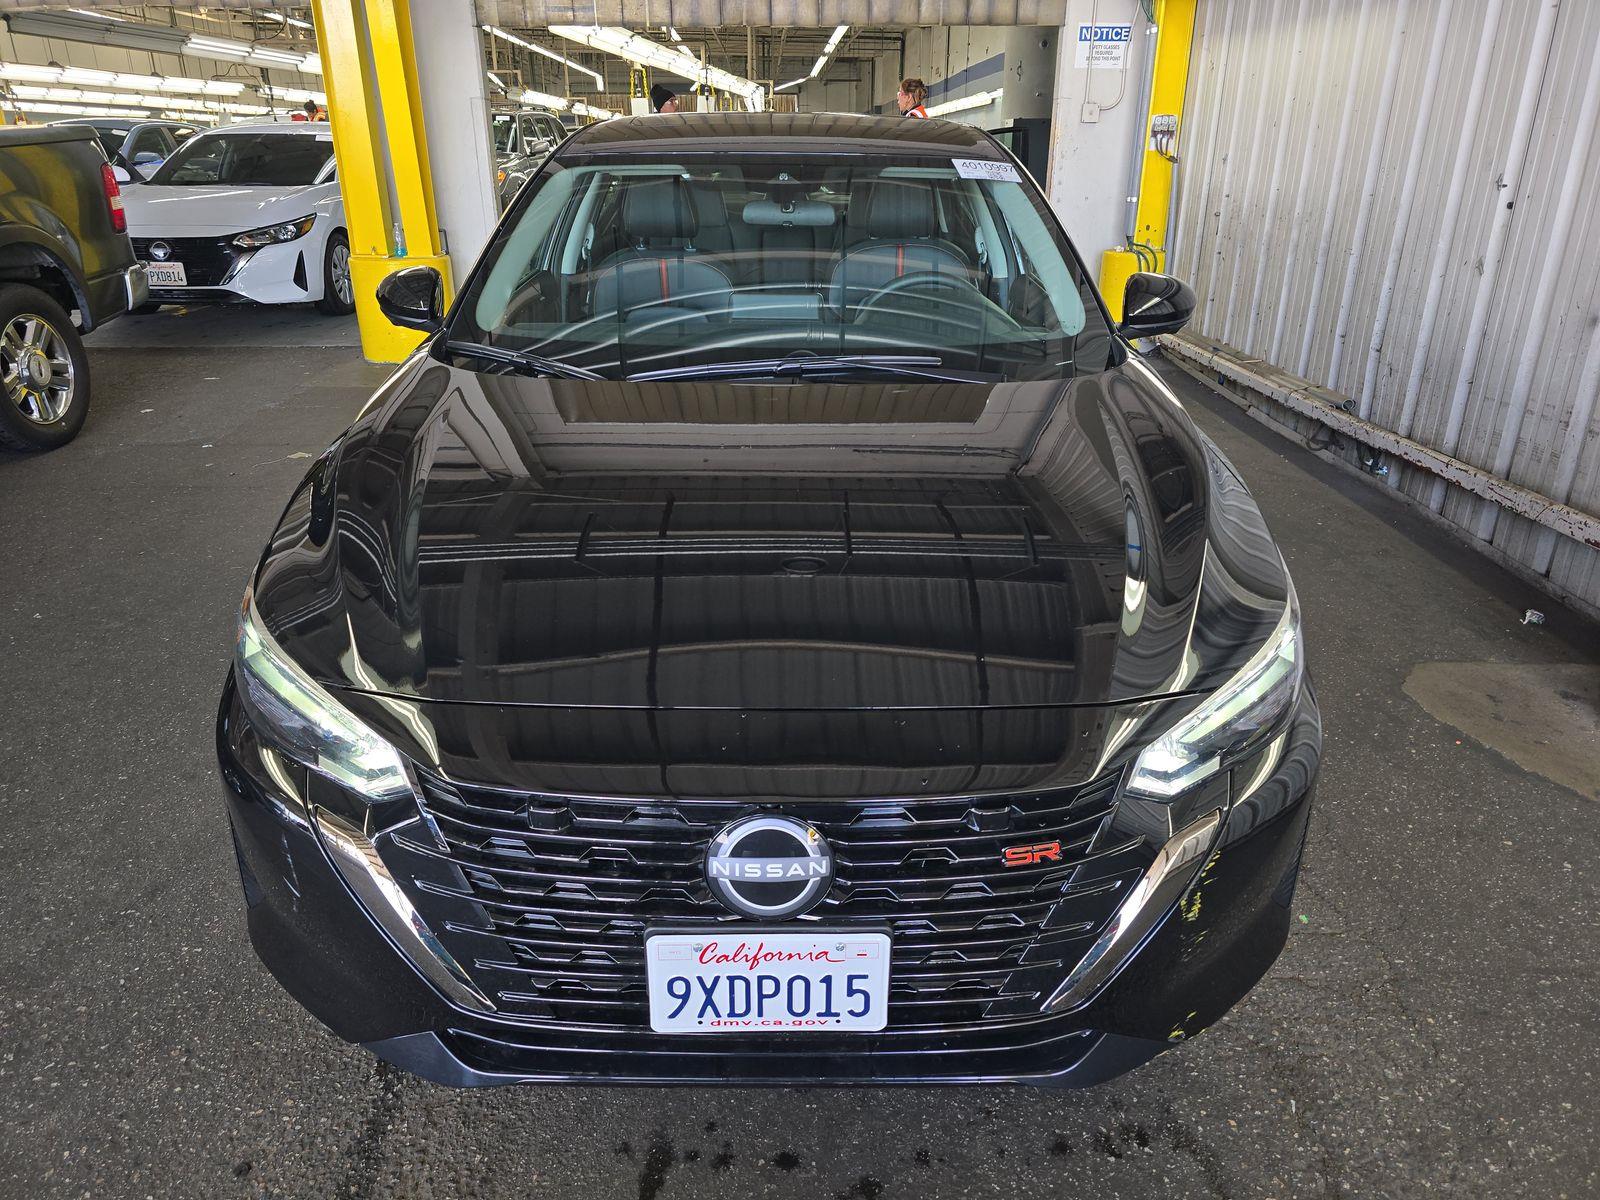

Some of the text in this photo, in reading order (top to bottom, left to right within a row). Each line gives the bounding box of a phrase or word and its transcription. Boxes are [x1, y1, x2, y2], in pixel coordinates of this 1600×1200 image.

[1081, 27, 1130, 40] NOTICE
[1003, 841, 1062, 862] SR
[712, 859, 827, 878] NISSAN
[698, 942, 846, 970] California
[666, 974, 871, 1019] 9XDP015
[710, 1018, 829, 1027] dmv.ca.gov
